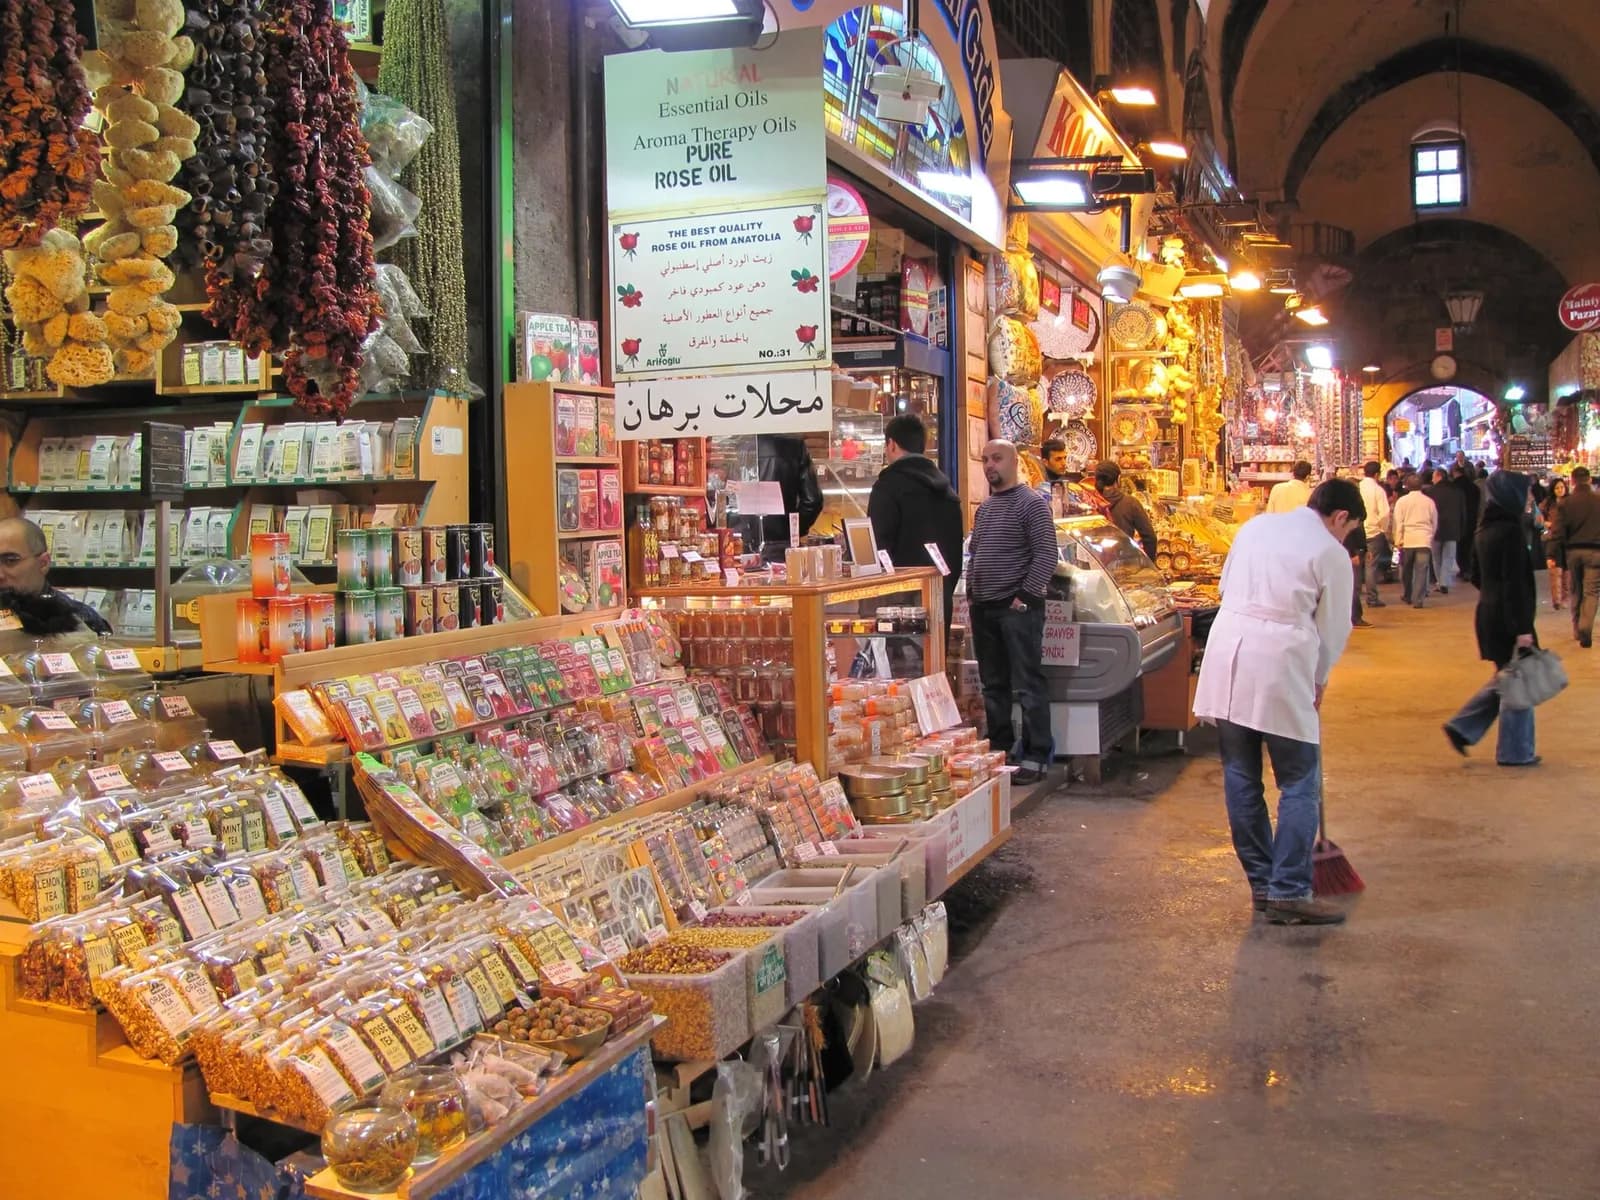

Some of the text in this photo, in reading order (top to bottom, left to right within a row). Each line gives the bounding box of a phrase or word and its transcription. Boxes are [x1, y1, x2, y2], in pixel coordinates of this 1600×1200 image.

[666, 64, 761, 95] NATURAL
[659, 91, 768, 118] Essential Oils
[633, 117, 797, 151] Aroma Therapy Oils
[686, 141, 733, 163] PURE
[655, 164, 737, 190] ROSE OIL
[668, 221, 763, 238] THE BEST QUALITY
[651, 232, 781, 253] ROSE OIL FROM ANATOLIA
[660, 253, 773, 277] زيت الورد أصلي إسطنبولي
[668, 281, 766, 299] دهن عود كمبودي فاخر
[663, 303, 774, 324] جميع أنواع العطور الأصلية
[529, 322, 570, 334] APPLE TEA
[689, 332, 749, 349] بالجملة والمفرق
[758, 348, 791, 358] NO.:31
[623, 382, 823, 432] محلات برهان
[222, 823, 241, 834] MINT
[251, 828, 261, 839] TEA
[228, 836, 239, 846] TEA
[76, 868, 98, 879] LEMON
[38, 876, 61, 890] LEMON
[83, 880, 94, 891] TEA
[45, 890, 58, 901] TEA
[114, 927, 137, 940] MINT
[160, 923, 178, 934] ROSE
[494, 969, 505, 980] TEA
[184, 977, 208, 993] ORANGE
[196, 987, 207, 995] TEA
[149, 989, 175, 1005] ORANGE
[161, 997, 174, 1007] TEA
[393, 1010, 412, 1025] ROSE
[368, 1023, 389, 1037] ROSE
[404, 1024, 418, 1034] TEA
[379, 1036, 394, 1047] TEA
